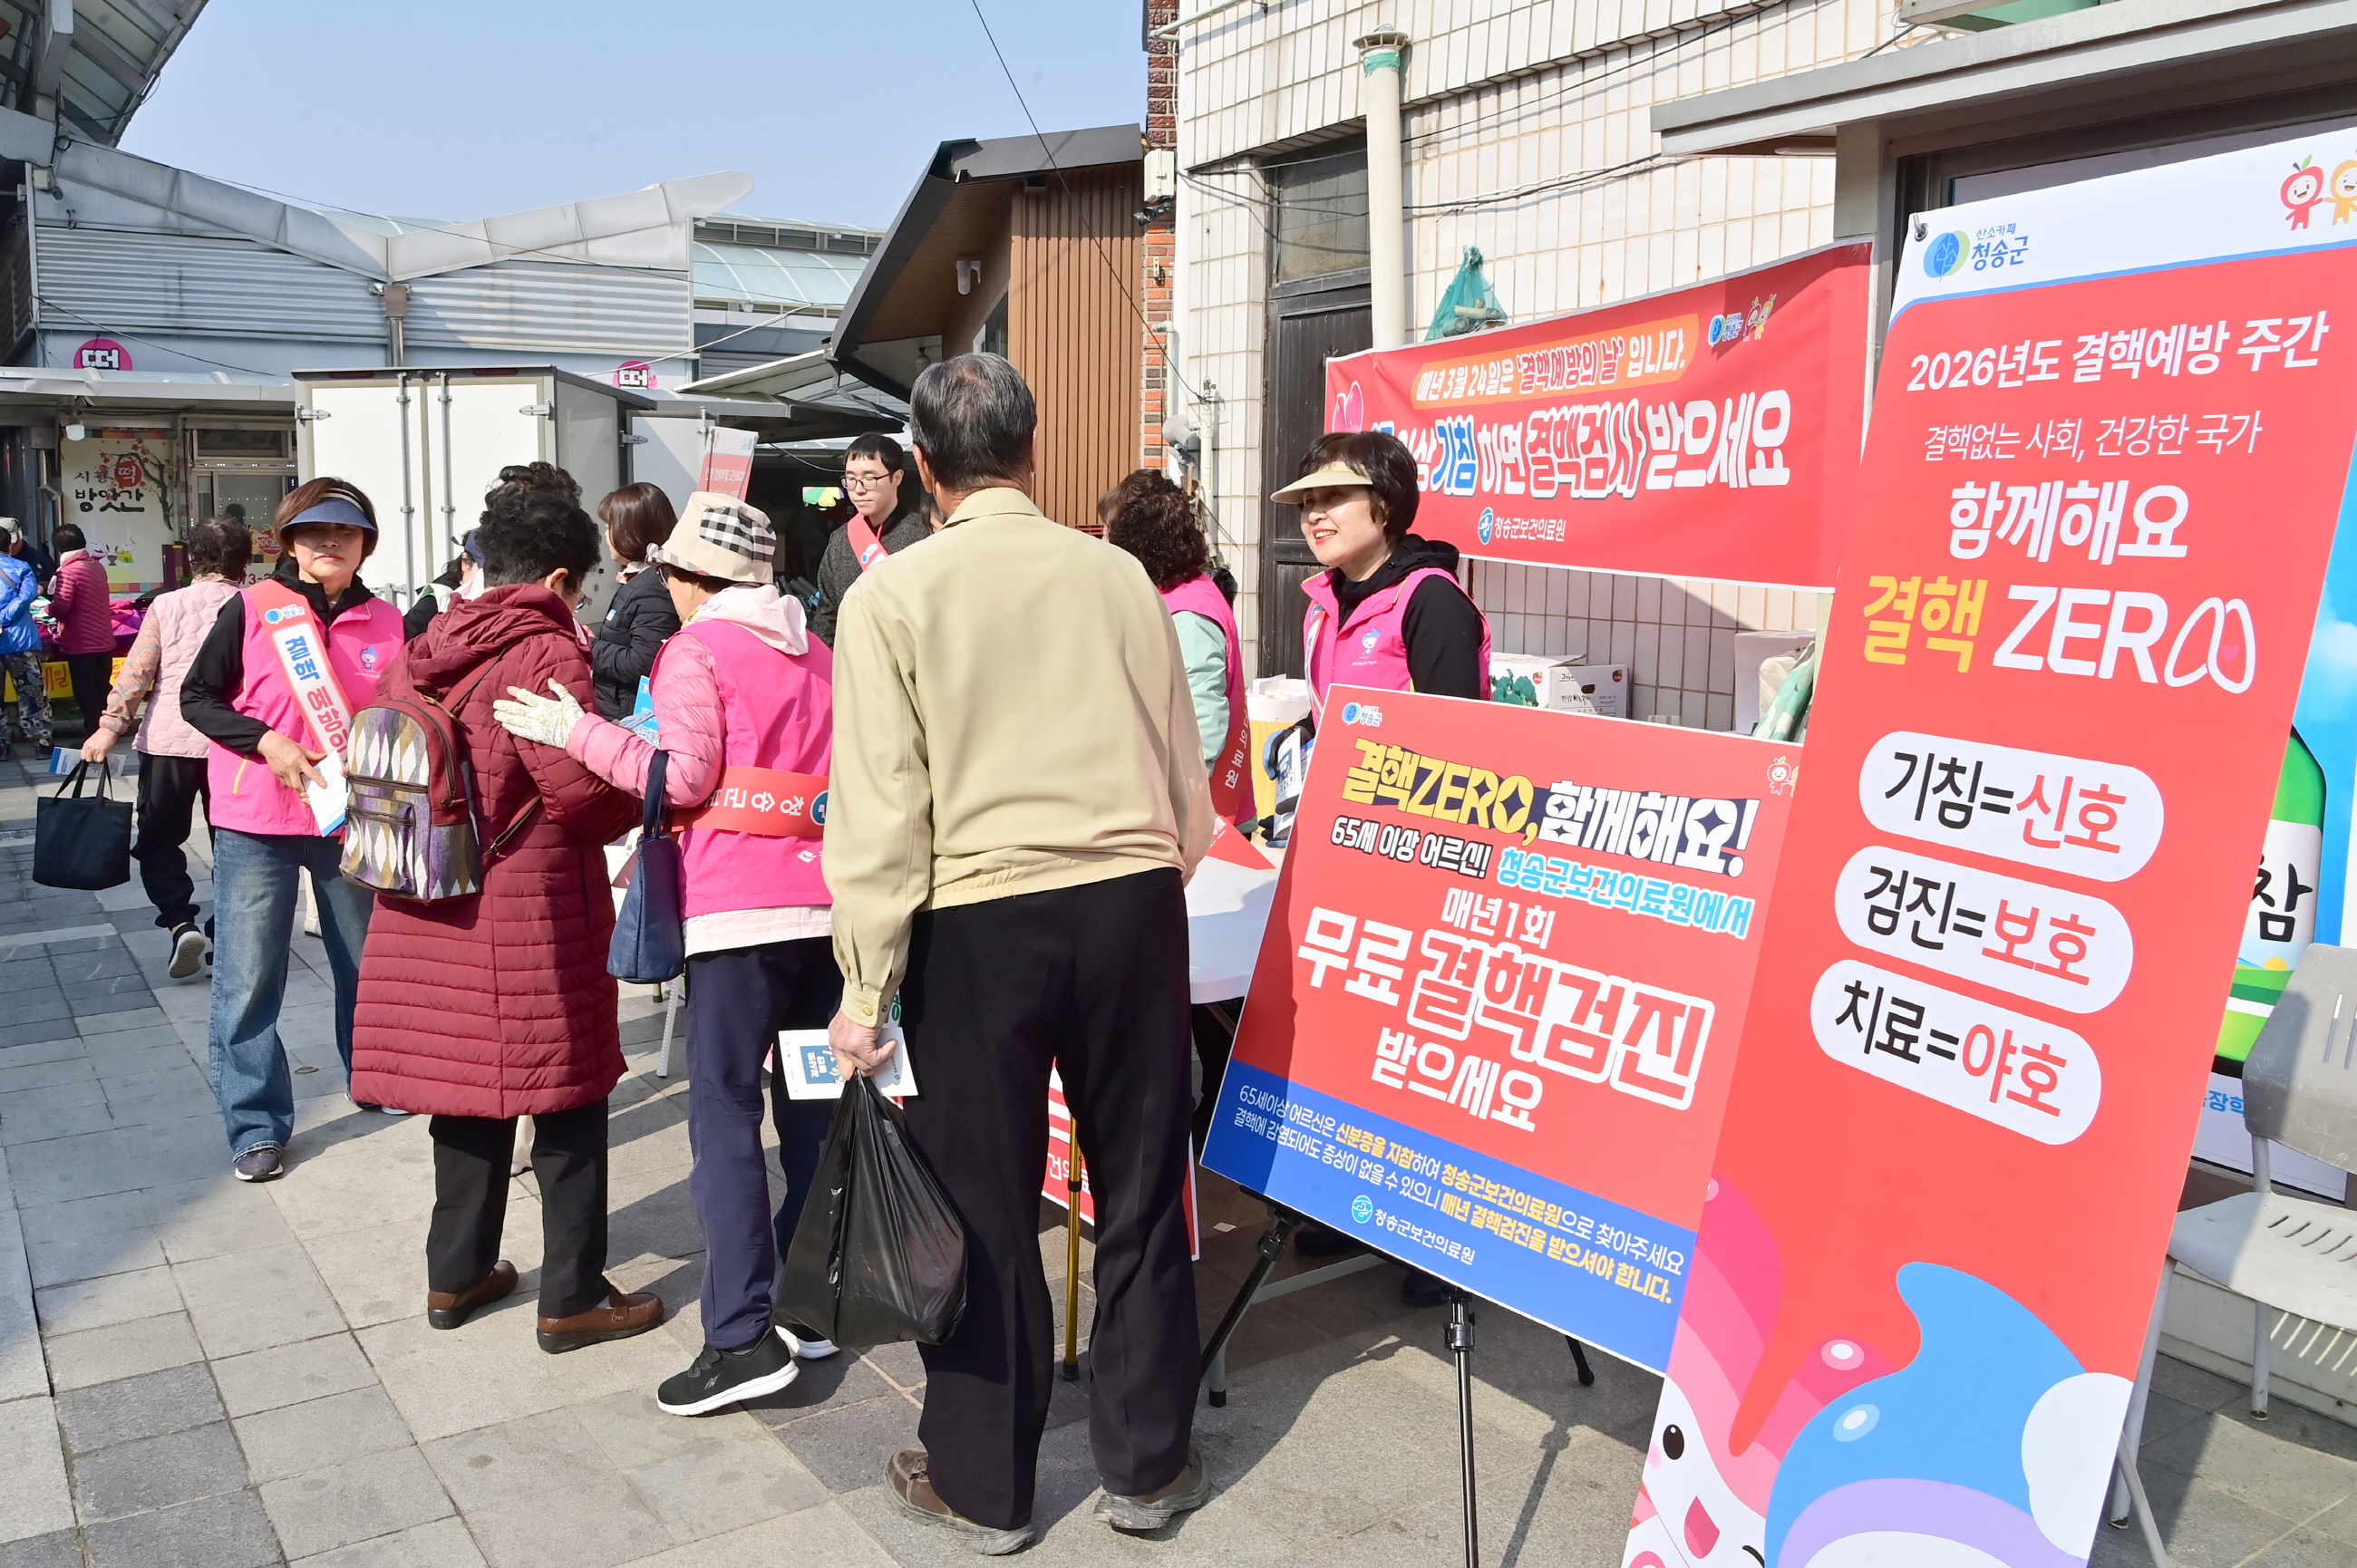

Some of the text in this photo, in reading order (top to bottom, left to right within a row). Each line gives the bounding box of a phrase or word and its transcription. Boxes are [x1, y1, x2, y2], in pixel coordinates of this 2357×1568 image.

[1971, 236, 2029, 271] 청송군
[1976, 223, 2016, 240] 산소카페
[1416, 368, 1445, 402] 매년
[1443, 365, 1468, 400] 3월
[1467, 359, 1512, 397] 24일은
[1627, 327, 1685, 378] 입니다.
[1906, 310, 2330, 392] 2026년도 결핵예방 주간
[1645, 390, 1790, 489] 받으세요
[1924, 410, 2262, 462] 결핵없는 사회, 건강한 국가
[75, 488, 145, 512] 방앗간
[1495, 516, 1566, 542] 청송군보건의료원
[1949, 479, 2189, 566] 함께해요
[285, 635, 320, 681] 결핵
[1863, 575, 1988, 673] 결핵
[1884, 750, 2127, 855] 기침=신호
[1331, 816, 1756, 940] 65세 이상 어르신! 청송군보건의료원에서
[1863, 865, 2096, 987] 검진=보호
[1296, 905, 1715, 1110] 무료 결핵검진
[1834, 979, 2068, 1118] 치료=야호
[1371, 1026, 1543, 1133] 받으세요
[1234, 1107, 1673, 1304] 결핵에 감염되어도 증상이 없을 수 있으니 매년 결핵검진을 받으셔야 합니다.
[1289, 1104, 1336, 1137] 어르신은
[1335, 1122, 1388, 1158] 신분증을
[1385, 1141, 1441, 1181] 지참하여
[1440, 1163, 1595, 1241] 청송군보건의료원으로
[1595, 1223, 1684, 1276] 찾아주세요
[1374, 1208, 1476, 1266] 청송군보건의료원
